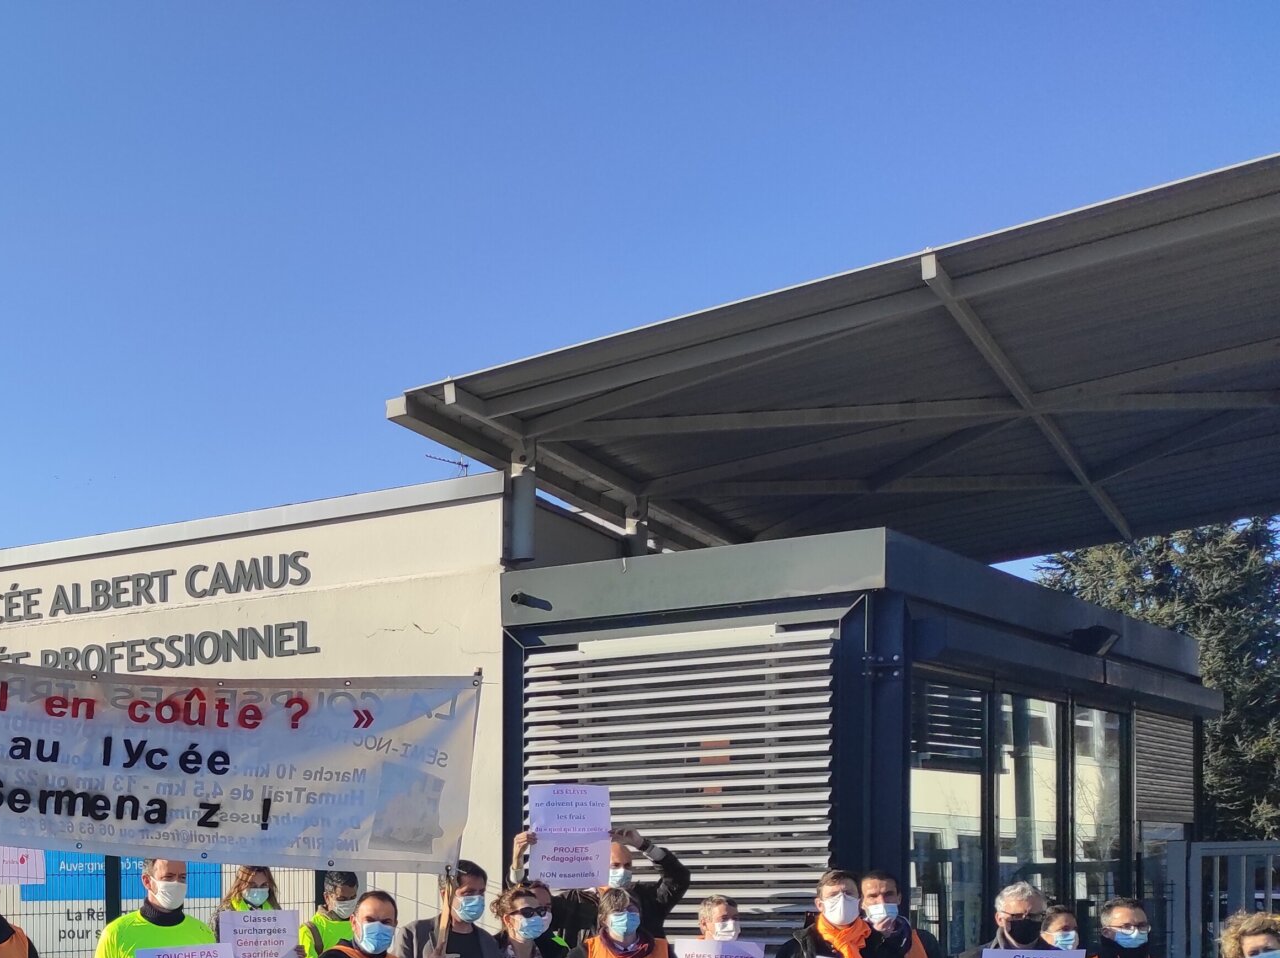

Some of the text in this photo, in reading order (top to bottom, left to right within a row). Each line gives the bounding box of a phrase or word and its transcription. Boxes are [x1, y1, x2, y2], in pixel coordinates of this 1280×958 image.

[49, 568, 177, 617] ALBERT
[185, 550, 312, 598] CAMUS
[41, 620, 320, 672] PROFESSIONNEL
[45, 695, 95, 719] en
[128, 688, 263, 729] coûte
[285, 697, 309, 729] ?
[10, 737, 59, 763] au
[102, 736, 231, 775] lycée
[66, 908, 82, 922] La
[242, 915, 277, 924] Classes
[58, 928, 94, 942] pour
[233, 927, 287, 936] surchargées
[236, 938, 285, 947] Génération
[200, 949, 219, 958] PAS
[241, 950, 279, 958] sacrifiée
